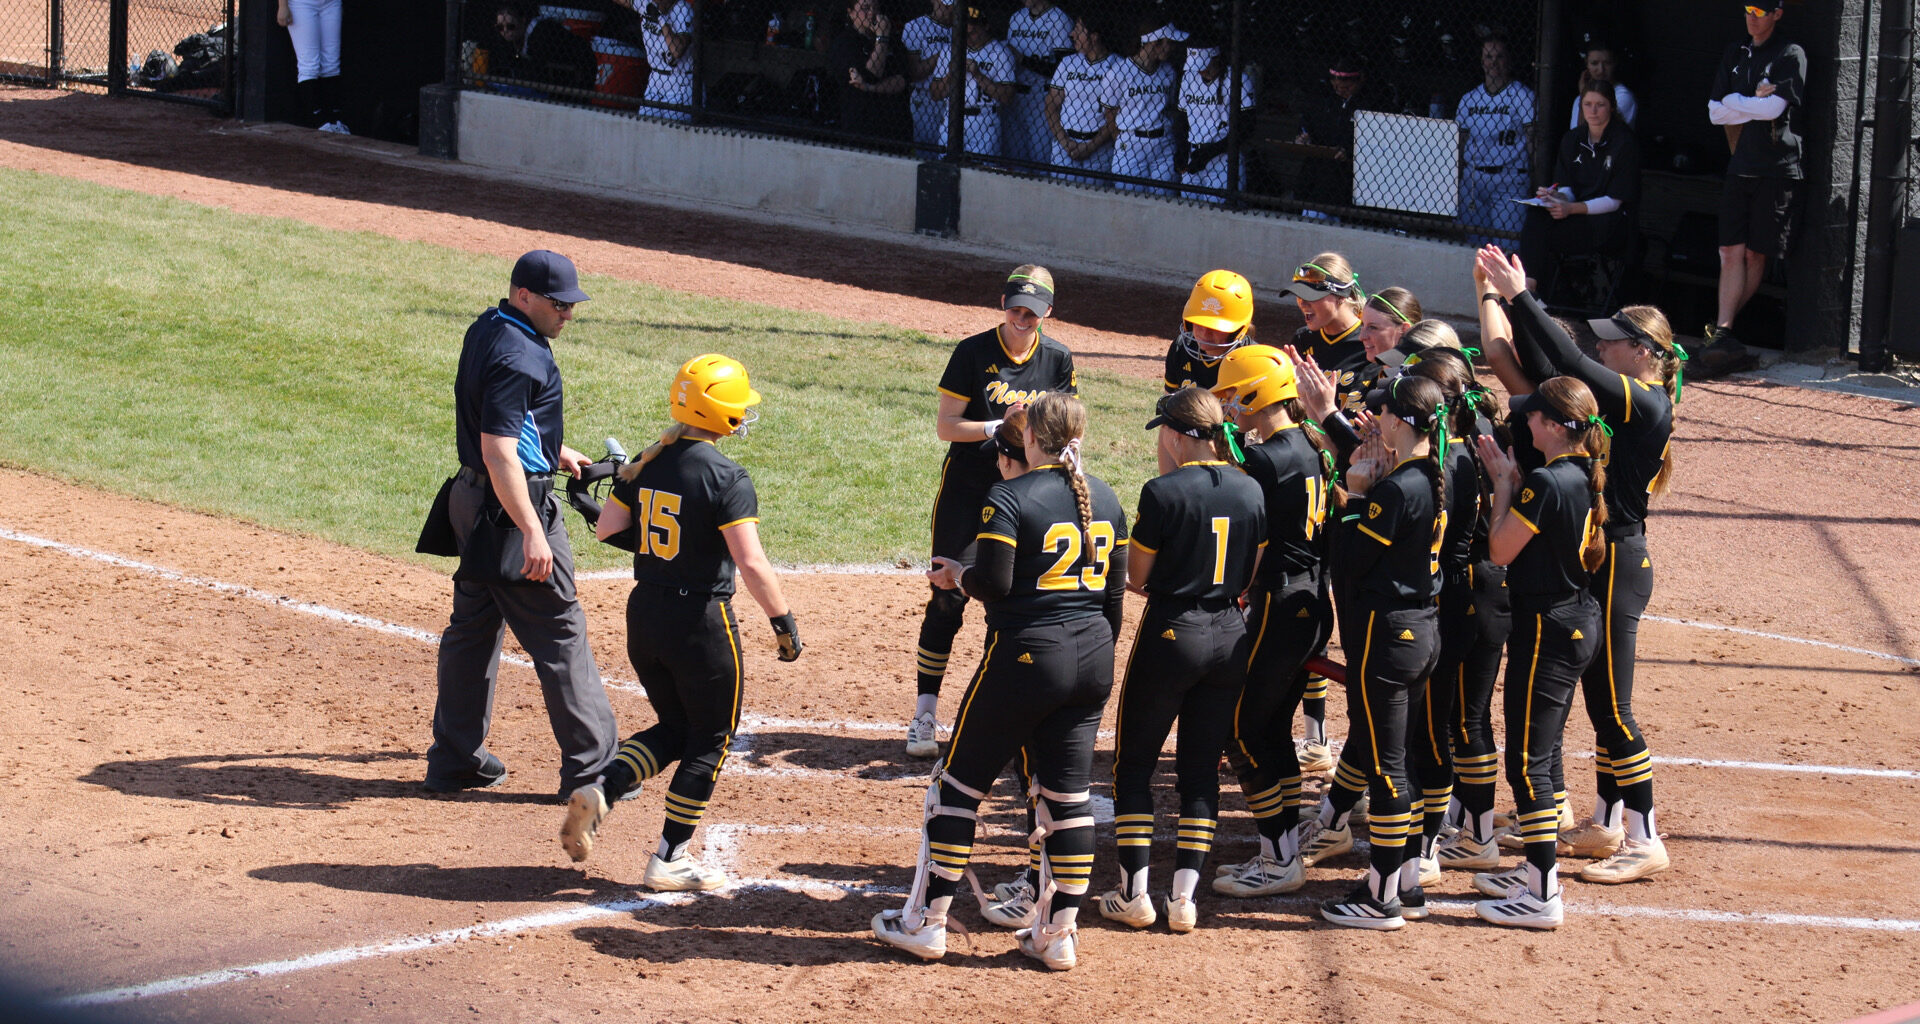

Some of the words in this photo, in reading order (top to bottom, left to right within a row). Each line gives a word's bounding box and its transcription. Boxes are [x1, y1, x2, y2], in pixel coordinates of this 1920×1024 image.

[639, 487, 683, 561] 15
[1305, 475, 1328, 541] 14
[1036, 520, 1115, 591] 23
[1211, 516, 1231, 585] 1
